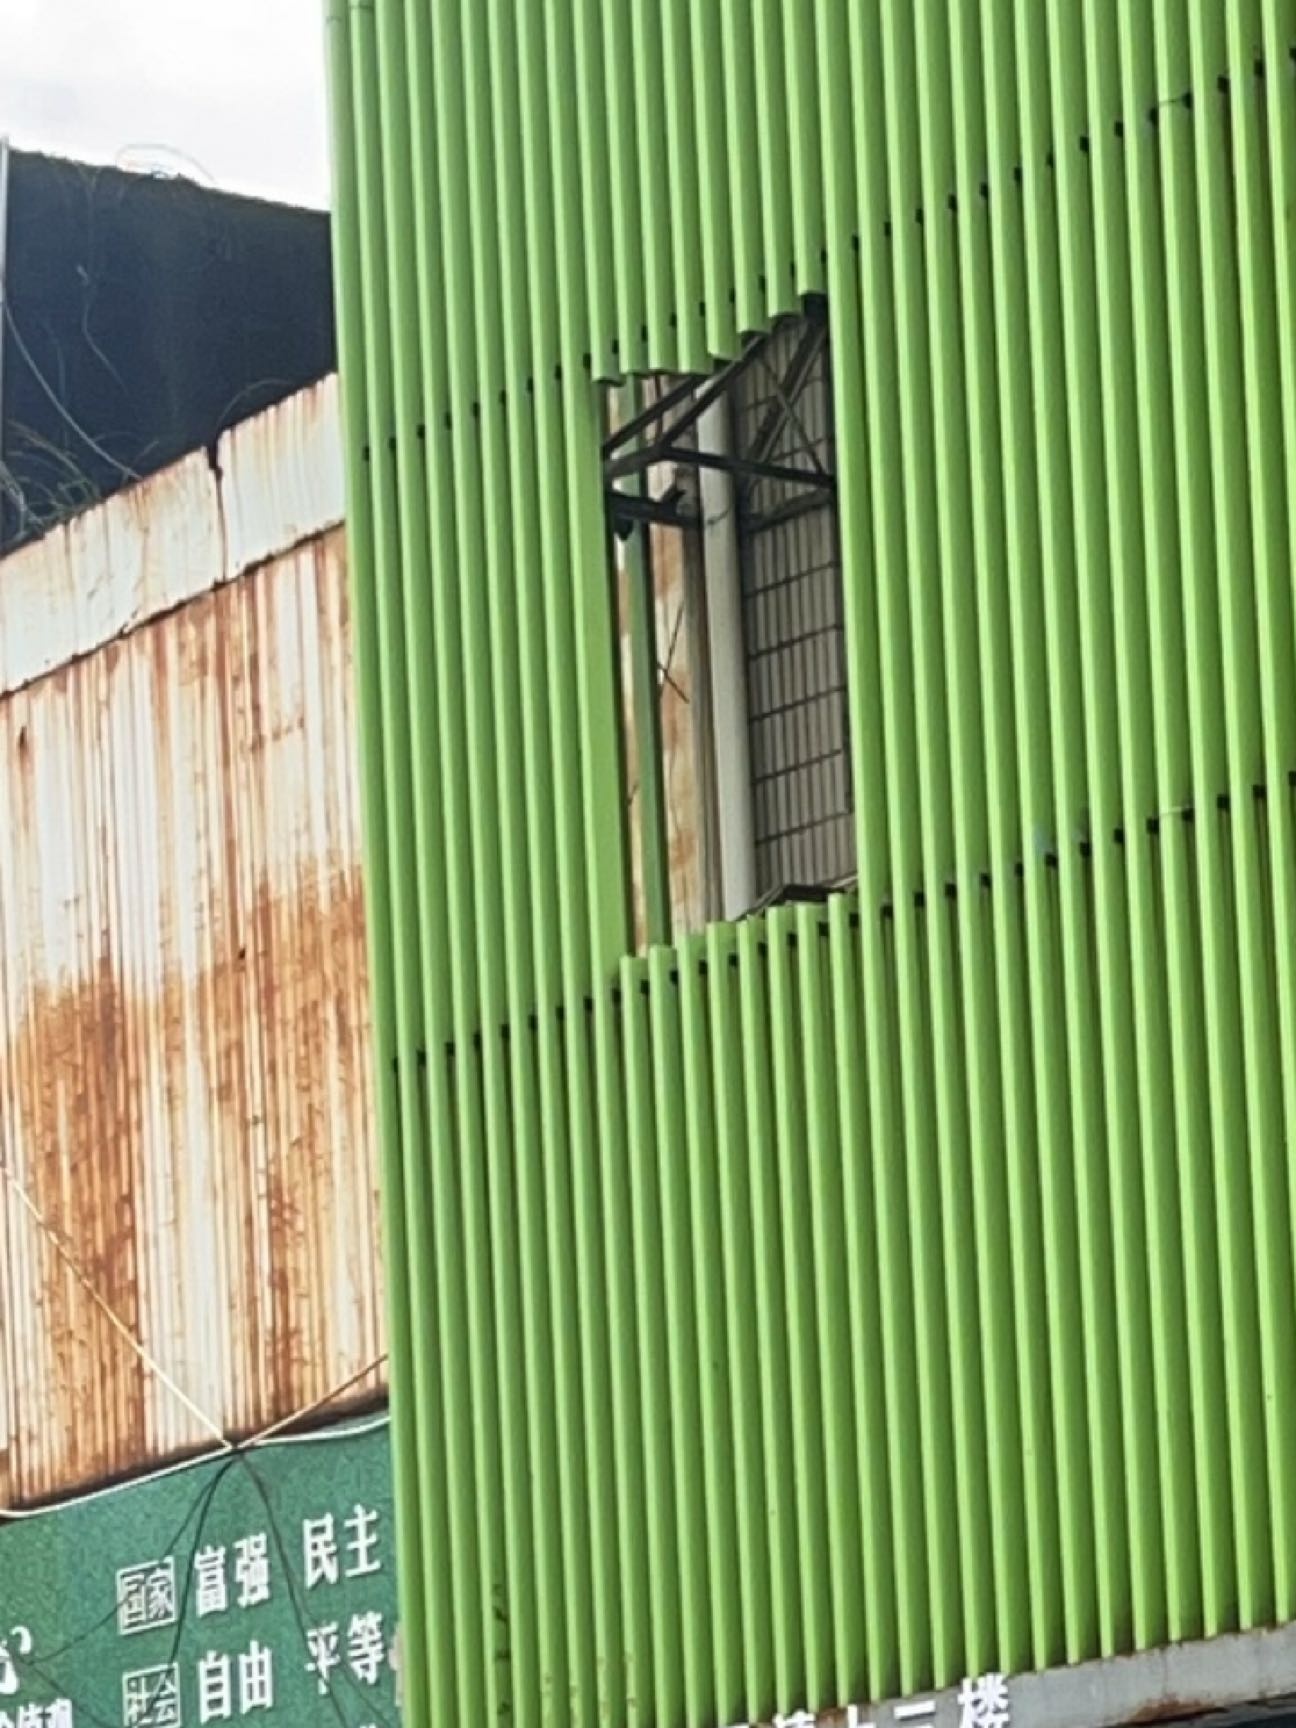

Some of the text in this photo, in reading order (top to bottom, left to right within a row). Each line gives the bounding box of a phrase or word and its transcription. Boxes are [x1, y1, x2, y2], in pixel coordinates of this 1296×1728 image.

[121, 1503, 382, 1631] 国家 富强 民主
[198, 1640, 273, 1724] 自由
[305, 1610, 385, 1695] 平等
